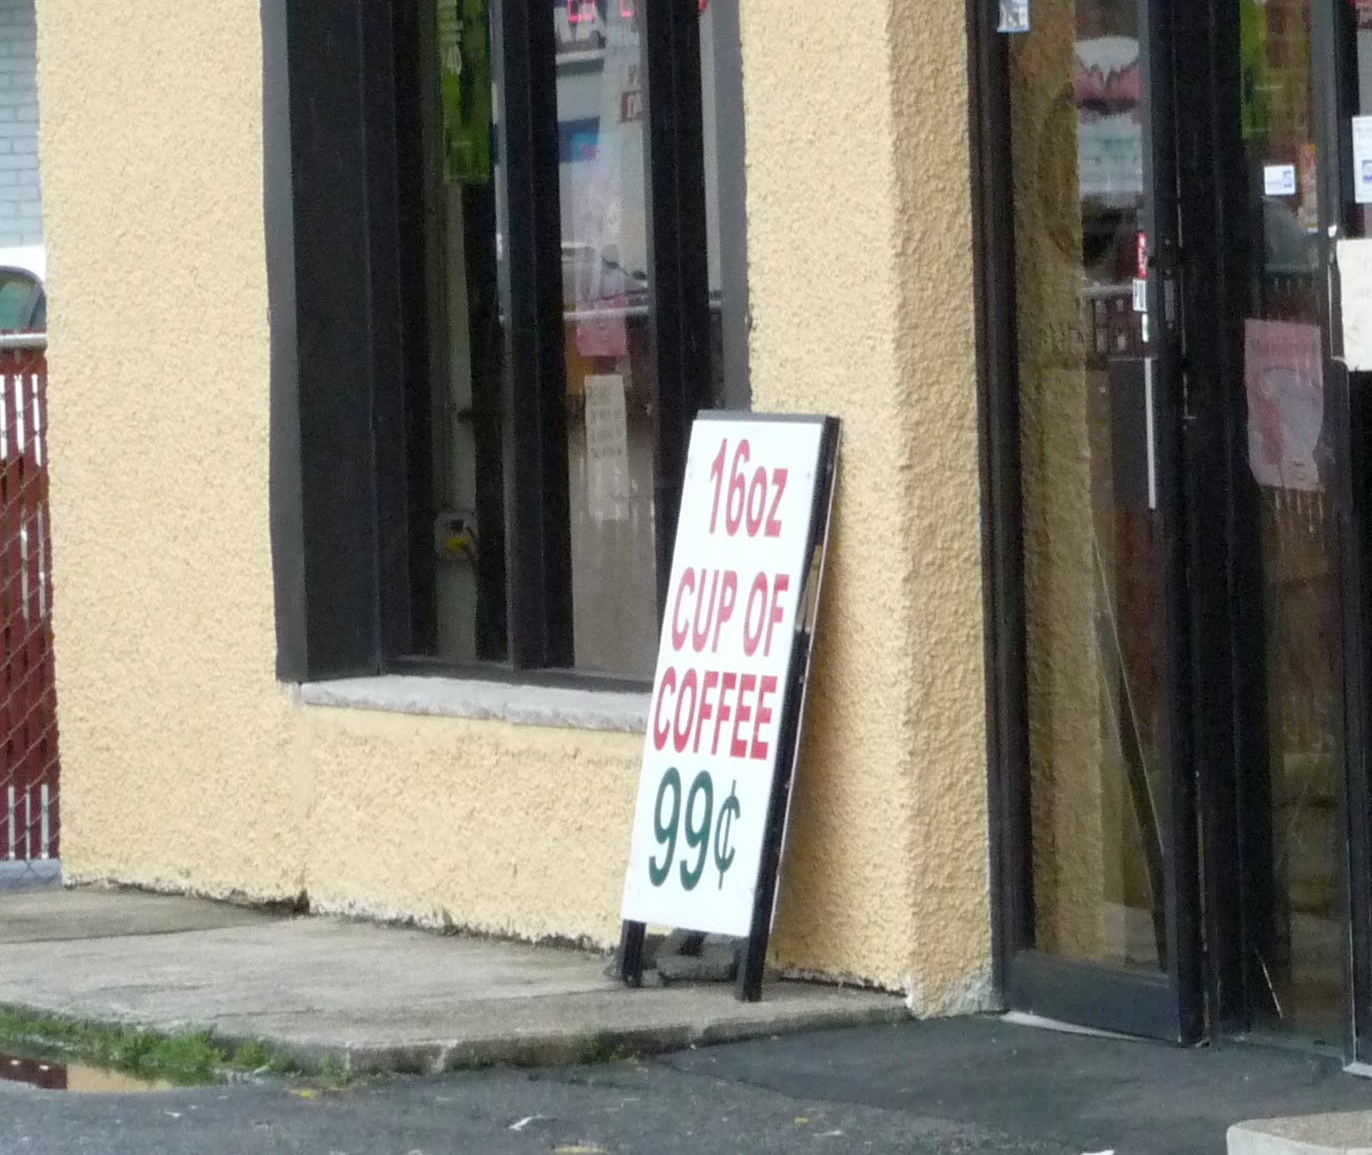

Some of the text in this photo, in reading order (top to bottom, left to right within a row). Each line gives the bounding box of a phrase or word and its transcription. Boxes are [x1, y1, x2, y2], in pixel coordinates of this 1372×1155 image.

[671, 566, 790, 658] CUP OF
[653, 666, 779, 761] COFFEE
